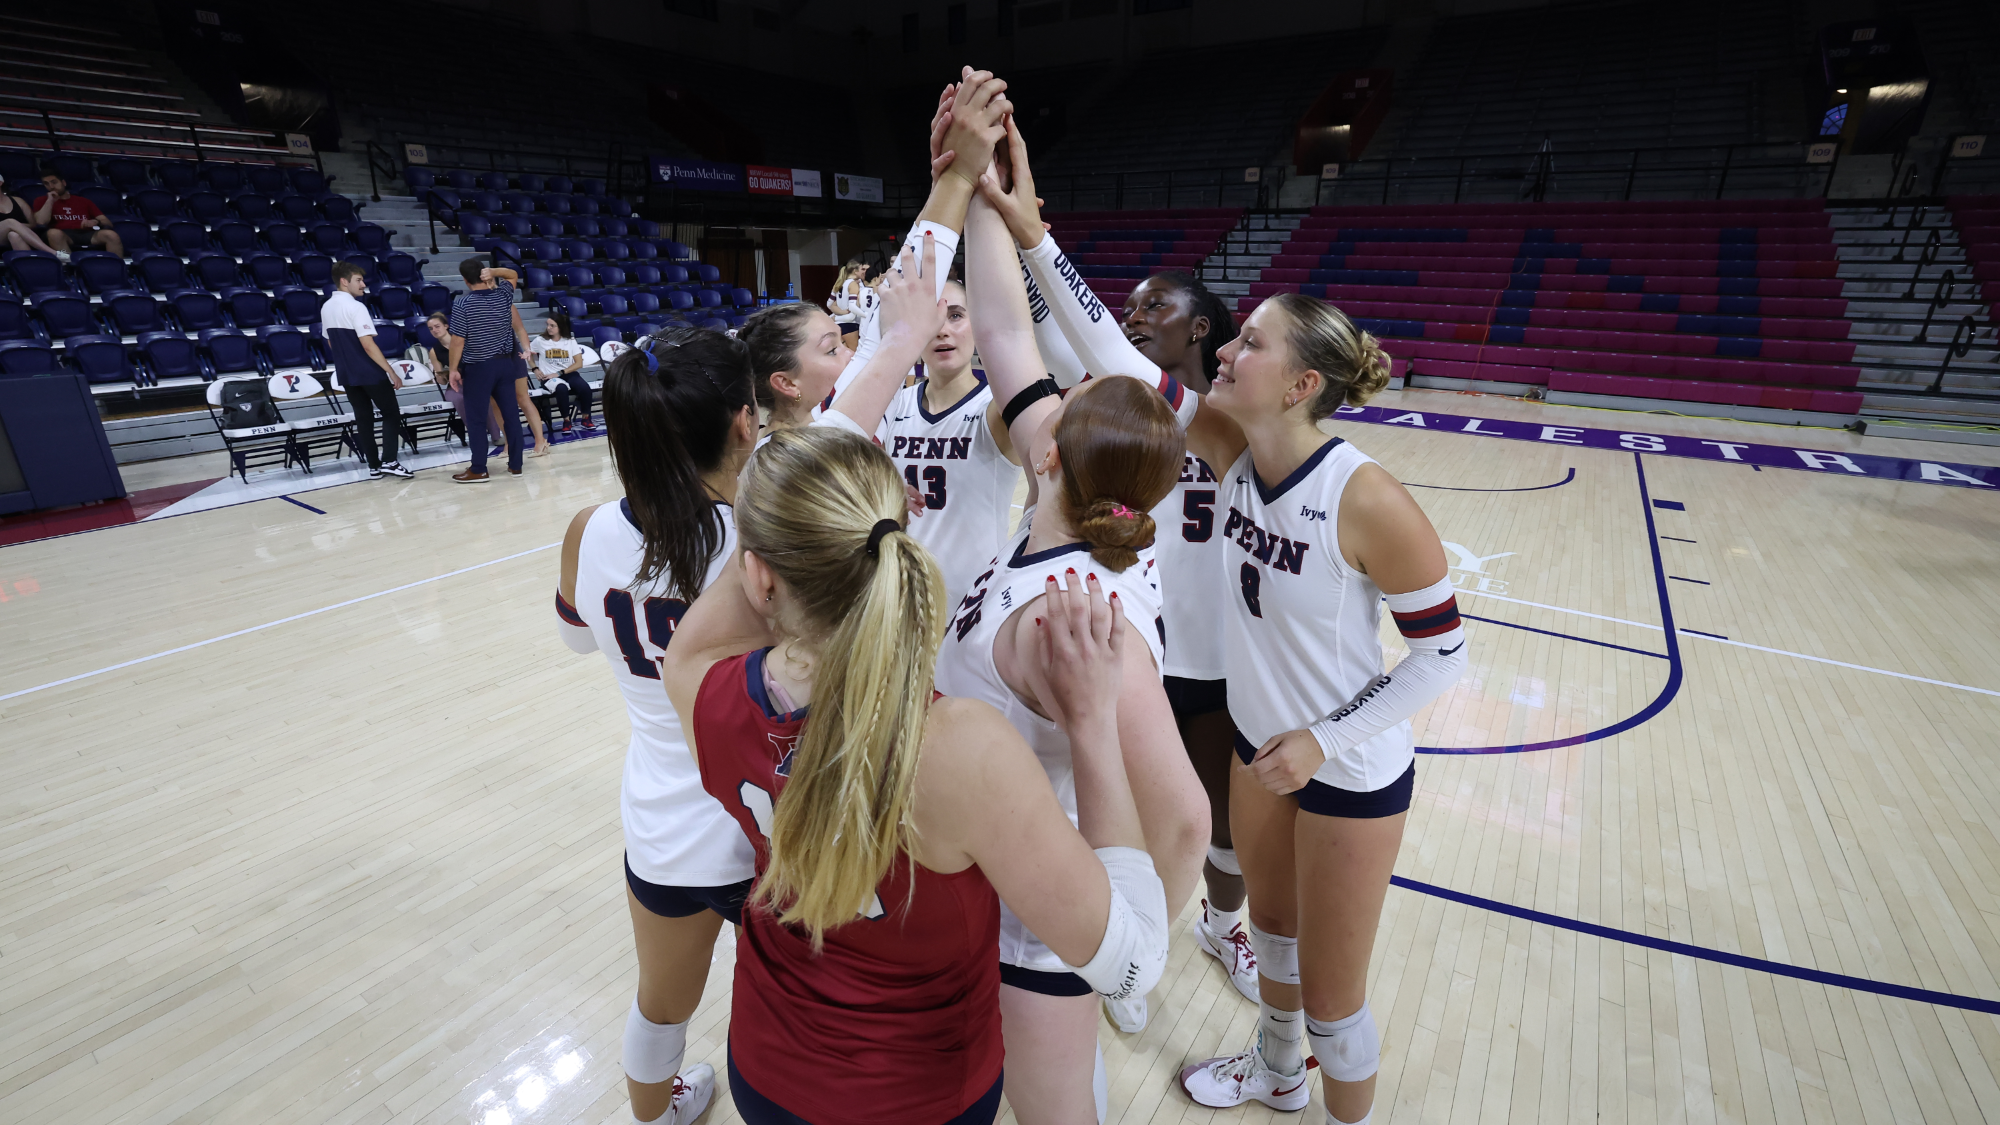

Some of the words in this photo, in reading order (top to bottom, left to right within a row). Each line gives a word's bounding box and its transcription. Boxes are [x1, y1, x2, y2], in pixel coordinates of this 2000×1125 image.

[220, 31, 244, 44] 205
[1828, 47, 1851, 58] 209
[1869, 43, 1891, 55] 210
[291, 139, 309, 149] 104
[1960, 140, 1979, 151] 110
[408, 149, 424, 158] 105
[1812, 148, 1831, 157] 109
[673, 165, 696, 178] Penn
[696, 167, 736, 181] Medicine
[749, 176, 759, 188] GO
[759, 177, 791, 190] QUAKERS!
[1053, 251, 1105, 323] QUAKERS
[866, 295, 873, 308] 3
[316, 418, 339, 426] PENN
[251, 426, 276, 434] PENN
[891, 435, 972, 460] PENN
[904, 464, 947, 511] 13
[1182, 489, 1216, 543] 5
[1223, 505, 1310, 576] PENN
